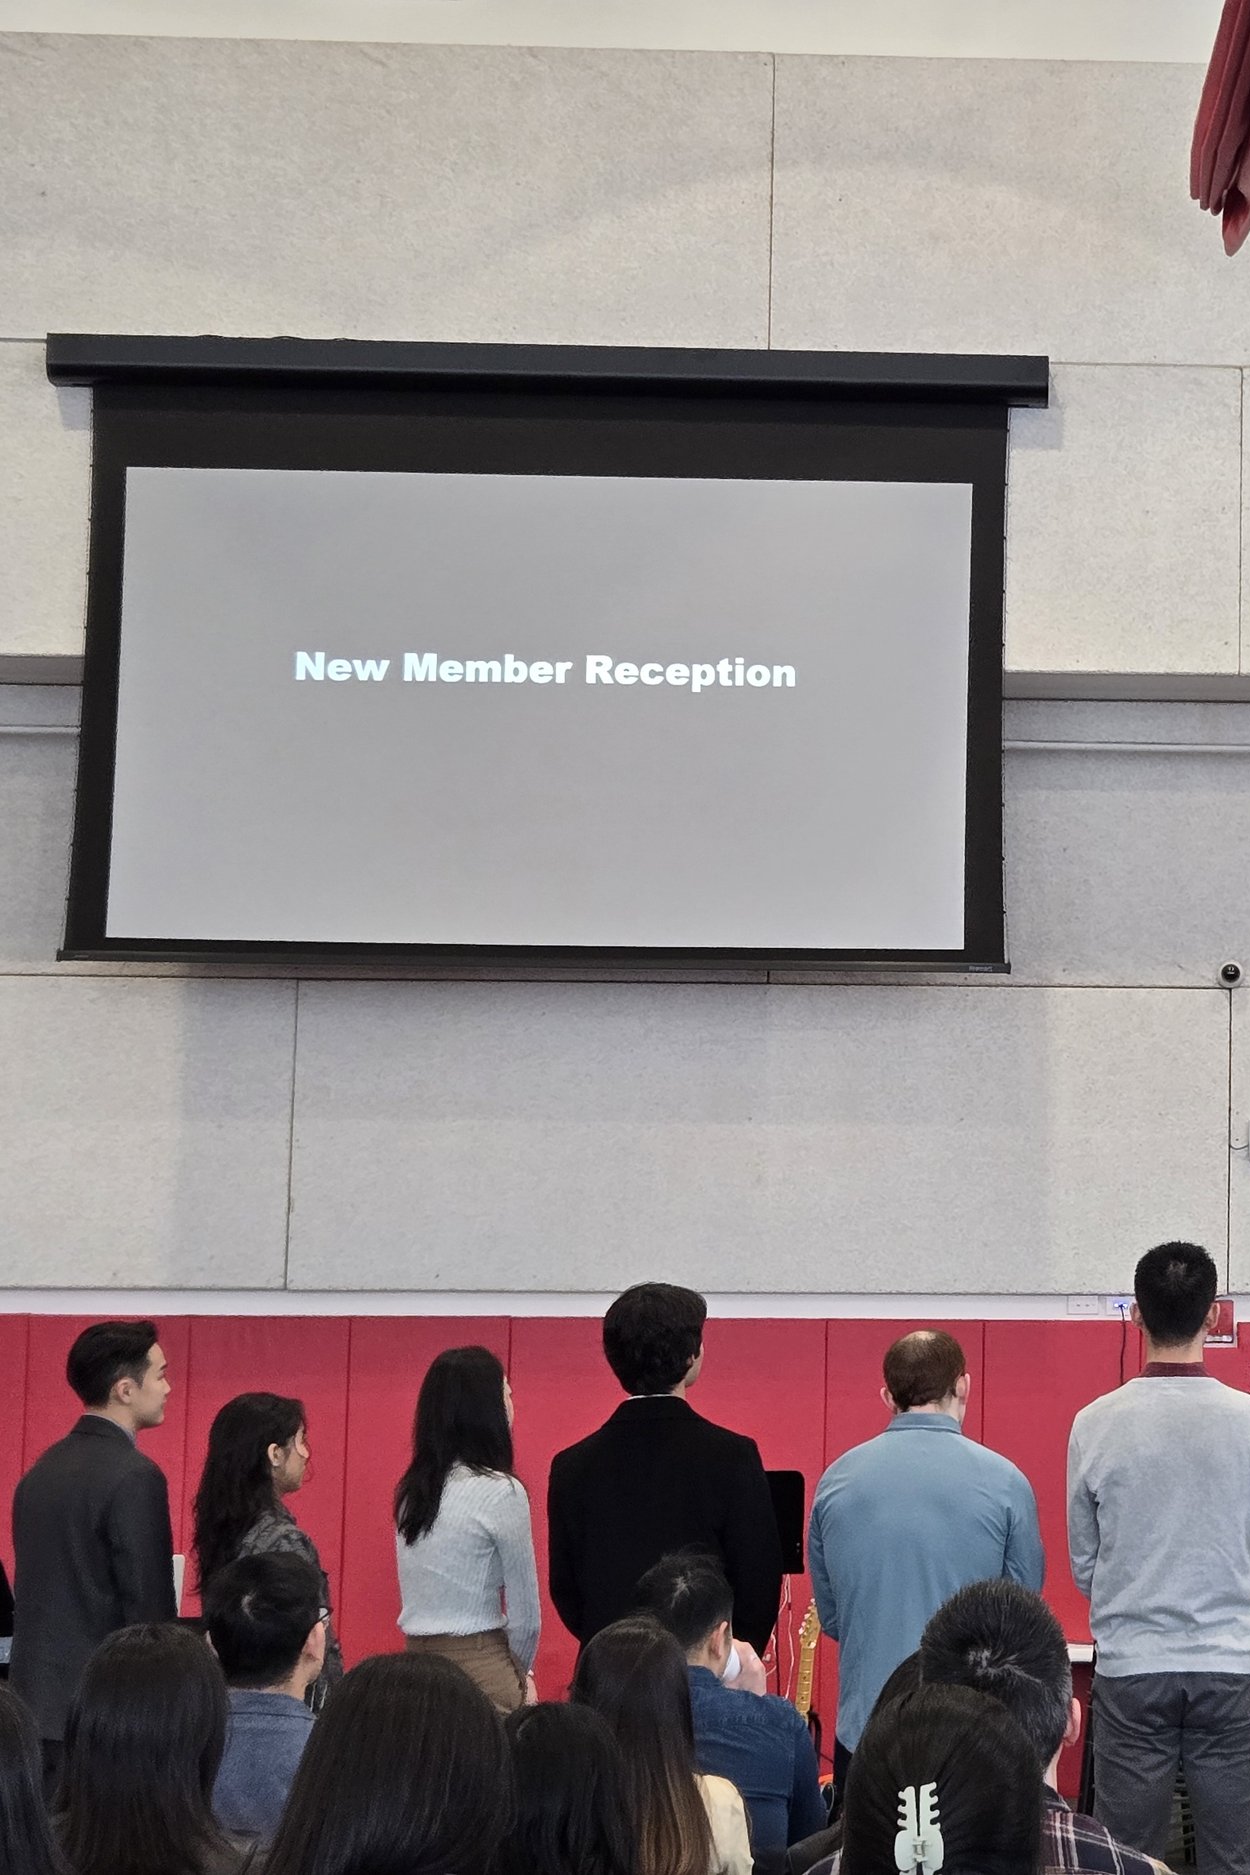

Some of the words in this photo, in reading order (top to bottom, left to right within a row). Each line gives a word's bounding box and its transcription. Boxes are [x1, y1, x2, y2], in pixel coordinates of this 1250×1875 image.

[294, 651, 390, 682] New
[403, 652, 574, 684] Member
[585, 654, 797, 693] Reception
